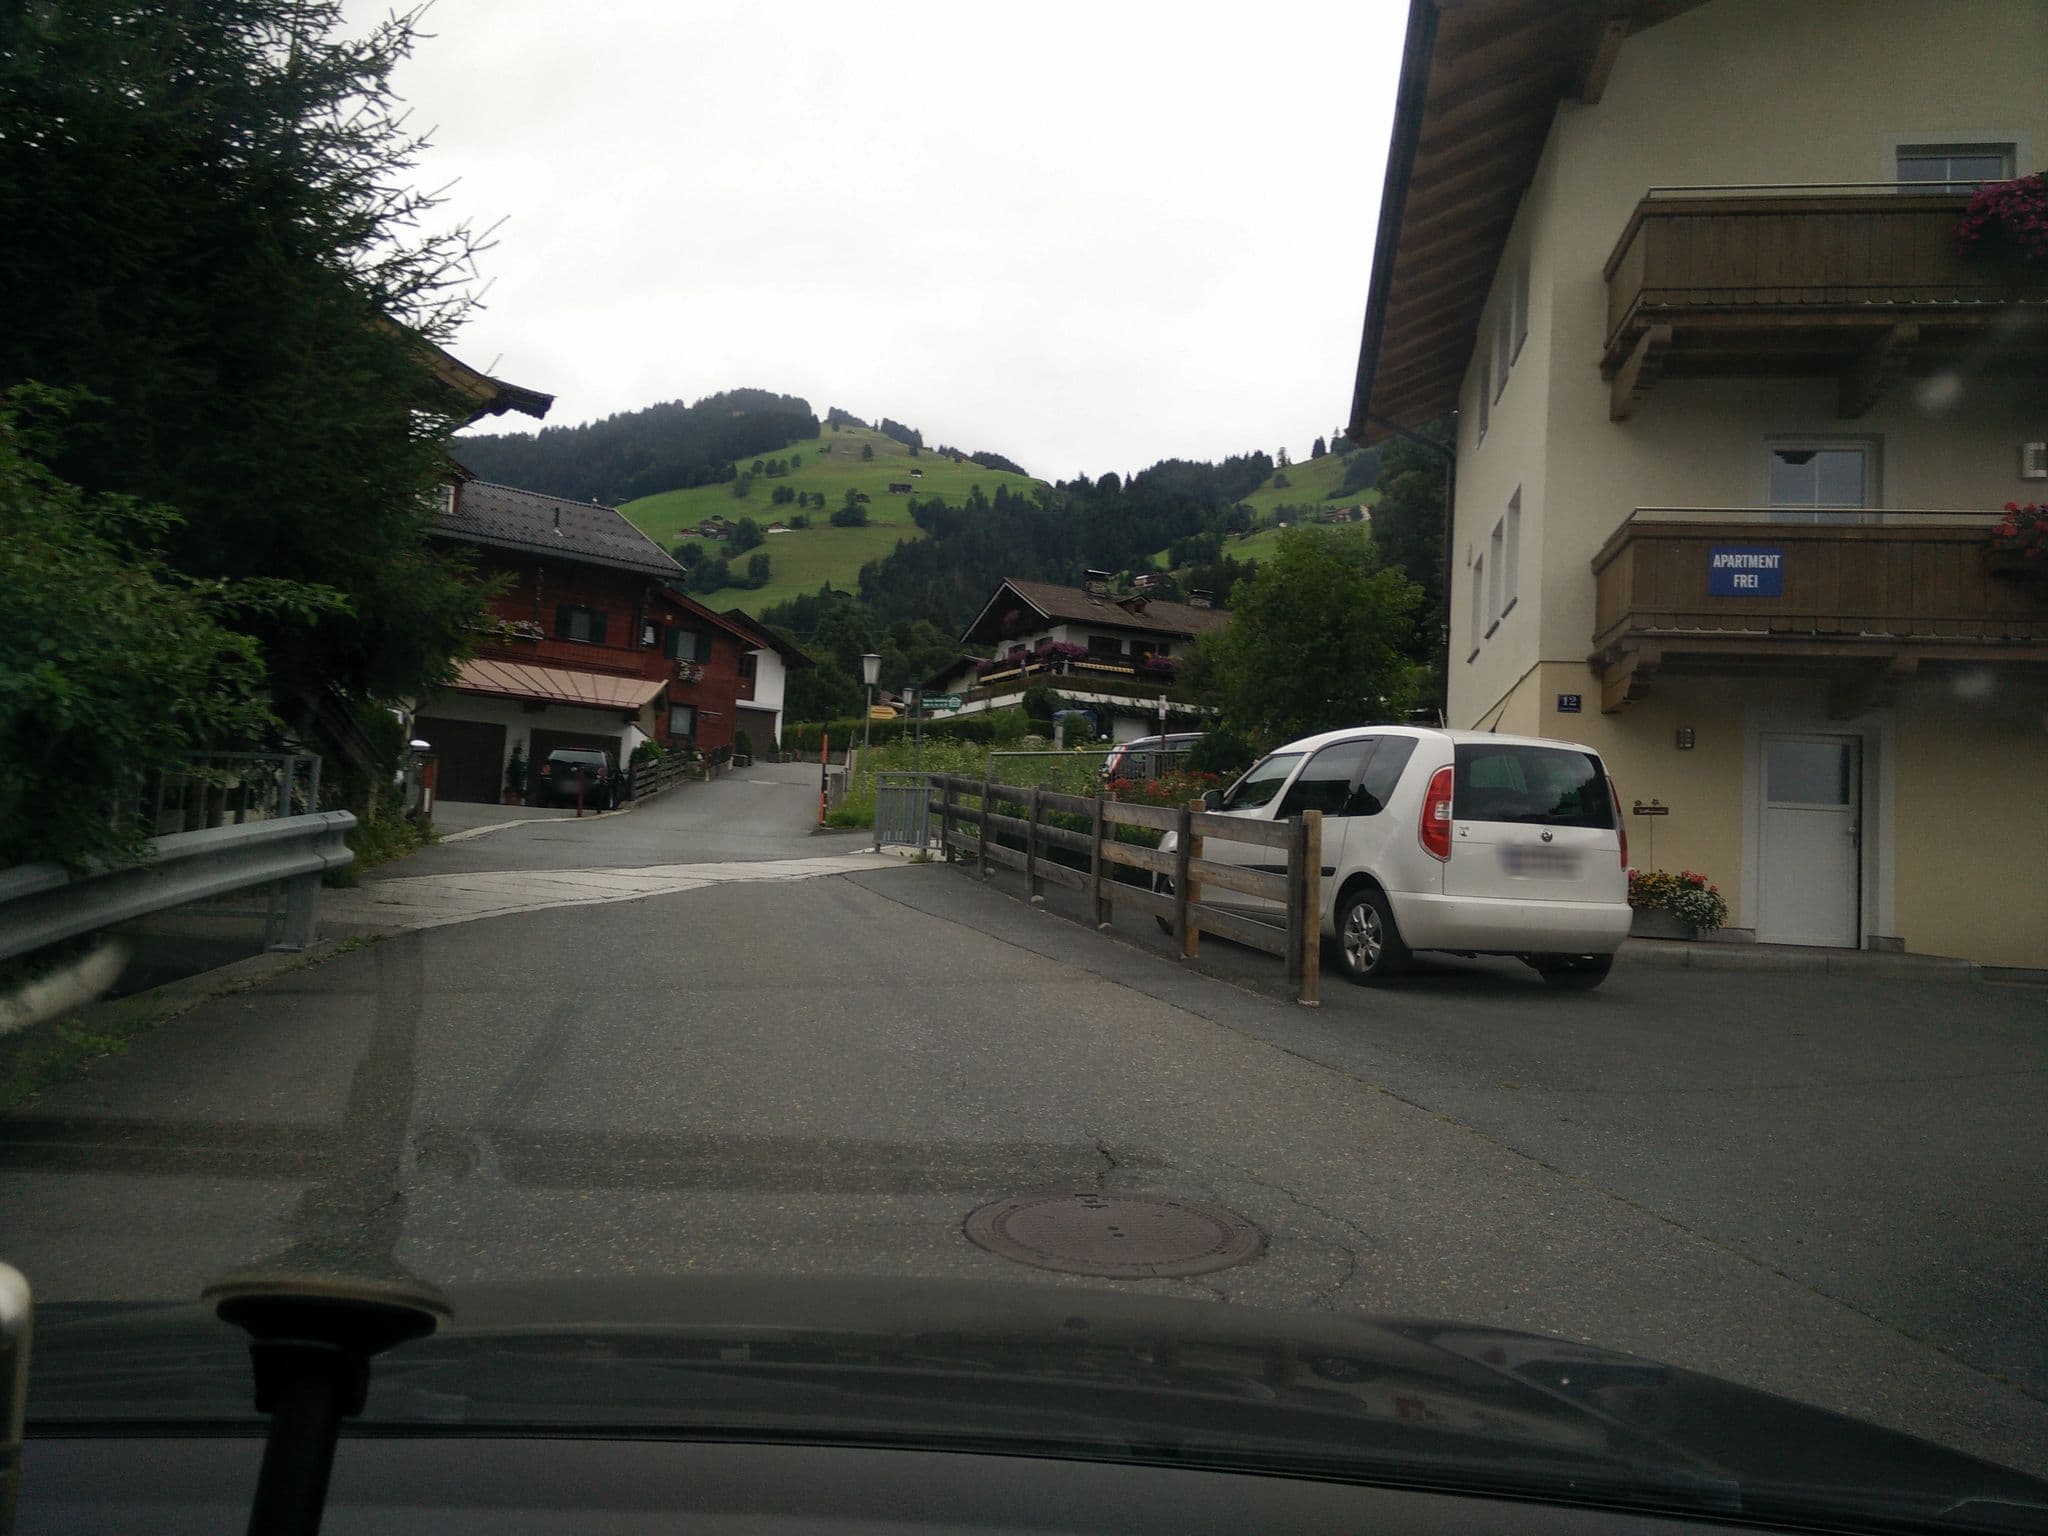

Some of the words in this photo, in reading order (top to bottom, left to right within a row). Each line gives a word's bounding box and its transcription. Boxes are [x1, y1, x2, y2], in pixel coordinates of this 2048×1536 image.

[1713, 554, 1780, 569] APARTMENT
[1733, 574, 1759, 588] FREI
[1562, 695, 1577, 706] 12
